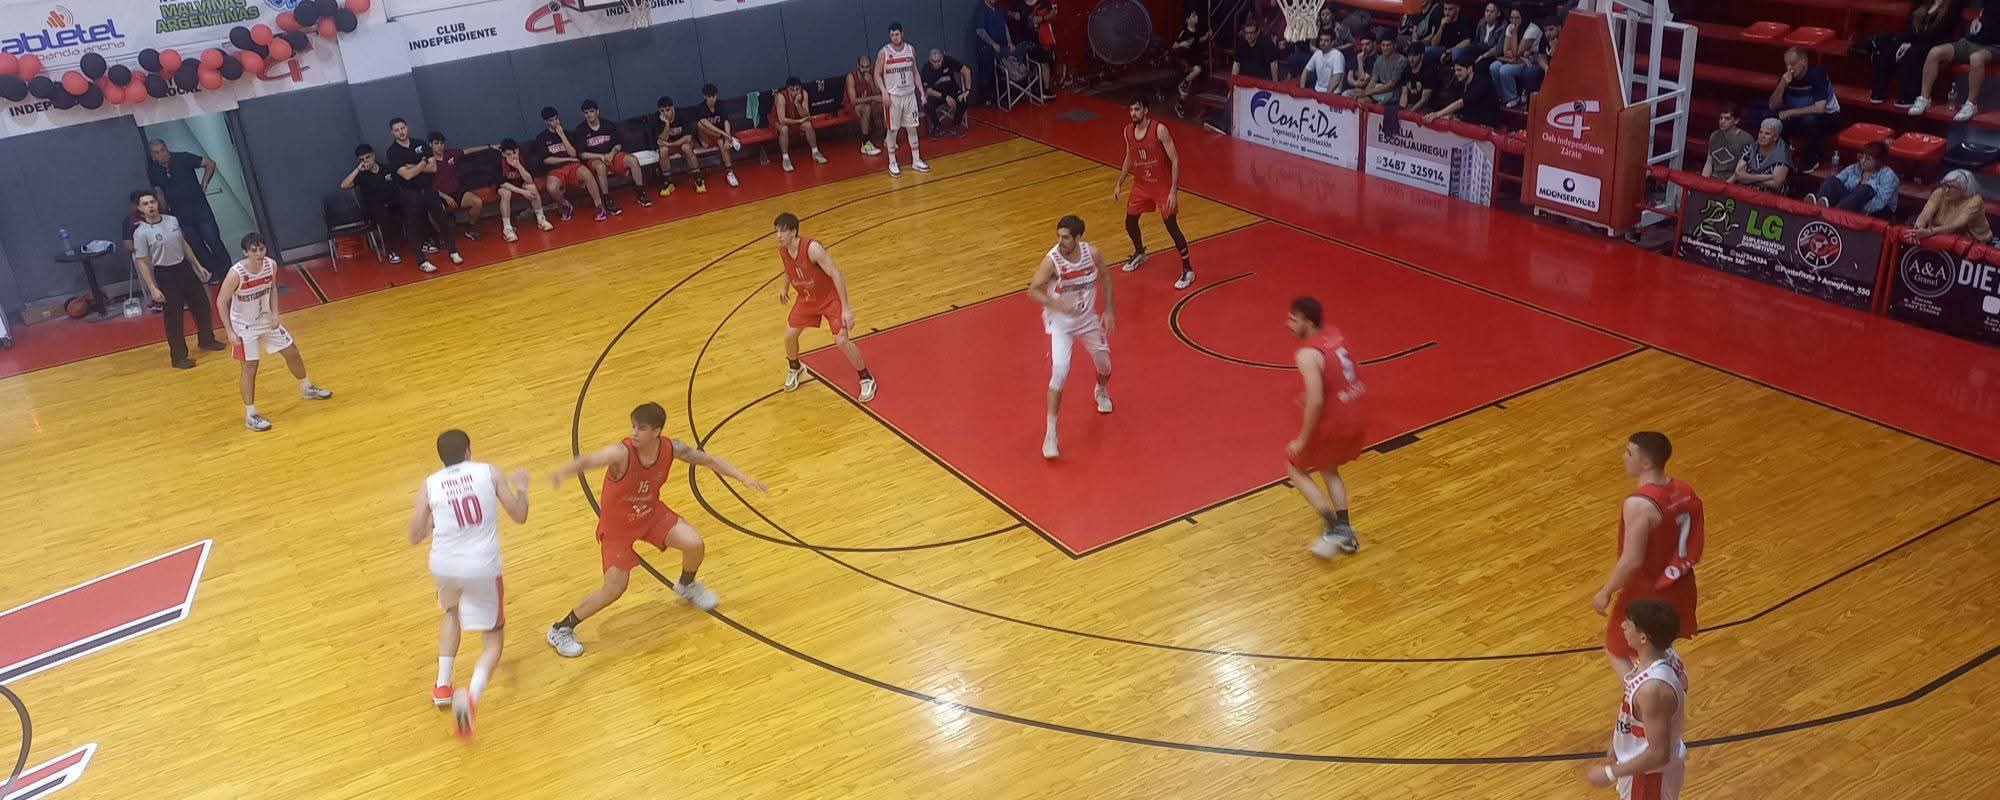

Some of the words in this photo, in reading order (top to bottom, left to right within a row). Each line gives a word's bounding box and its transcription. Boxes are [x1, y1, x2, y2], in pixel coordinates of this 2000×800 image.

[159, 0, 248, 18] MALVINAS
[156, 6, 260, 34] ARGENTINAS
[436, 22, 466, 35] CLUB
[408, 27, 498, 51] INDEPENDIENTE
[1378, 133, 1448, 158] ESCONJAUREGUI
[1542, 132, 1557, 143] Club
[1557, 136, 1605, 155] Independiente
[1382, 157, 1406, 172] 3487
[1410, 163, 1445, 182] 325914
[1538, 187, 1596, 208] MOONSERVICES
[1745, 208, 1785, 241] LG
[1742, 235, 1786, 252] SUPLEMENTOS
[1803, 225, 1839, 246] PUNTO
[1805, 251, 1829, 266] FIT
[1909, 260, 1947, 281] A&A
[1821, 277, 1855, 292] Ameghino
[638, 480, 650, 494] 15
[449, 495, 482, 528] 10
